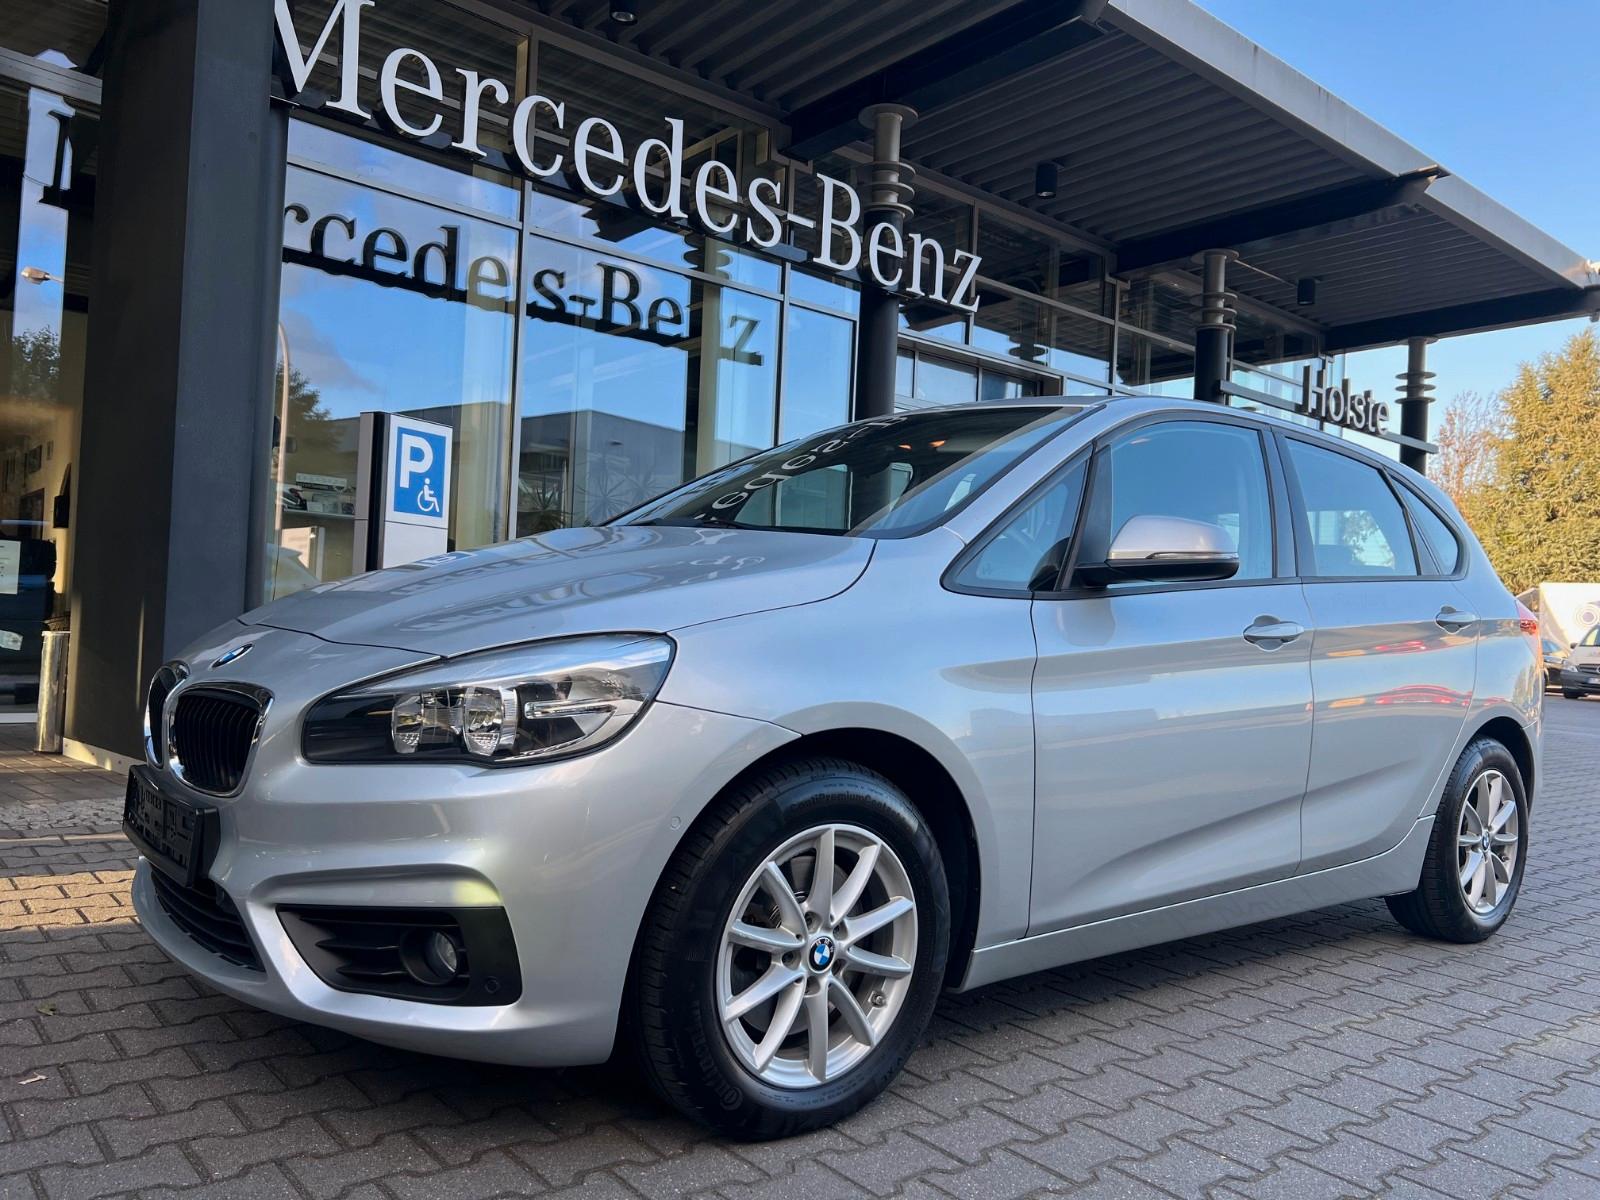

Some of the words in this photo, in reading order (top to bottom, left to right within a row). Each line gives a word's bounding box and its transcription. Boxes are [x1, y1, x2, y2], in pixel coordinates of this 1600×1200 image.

[274, 0, 982, 313] Mercedes-Benz
[1304, 365, 1390, 435] Holste
[400, 433, 433, 488] P
[688, 999, 744, 1111] Continen
